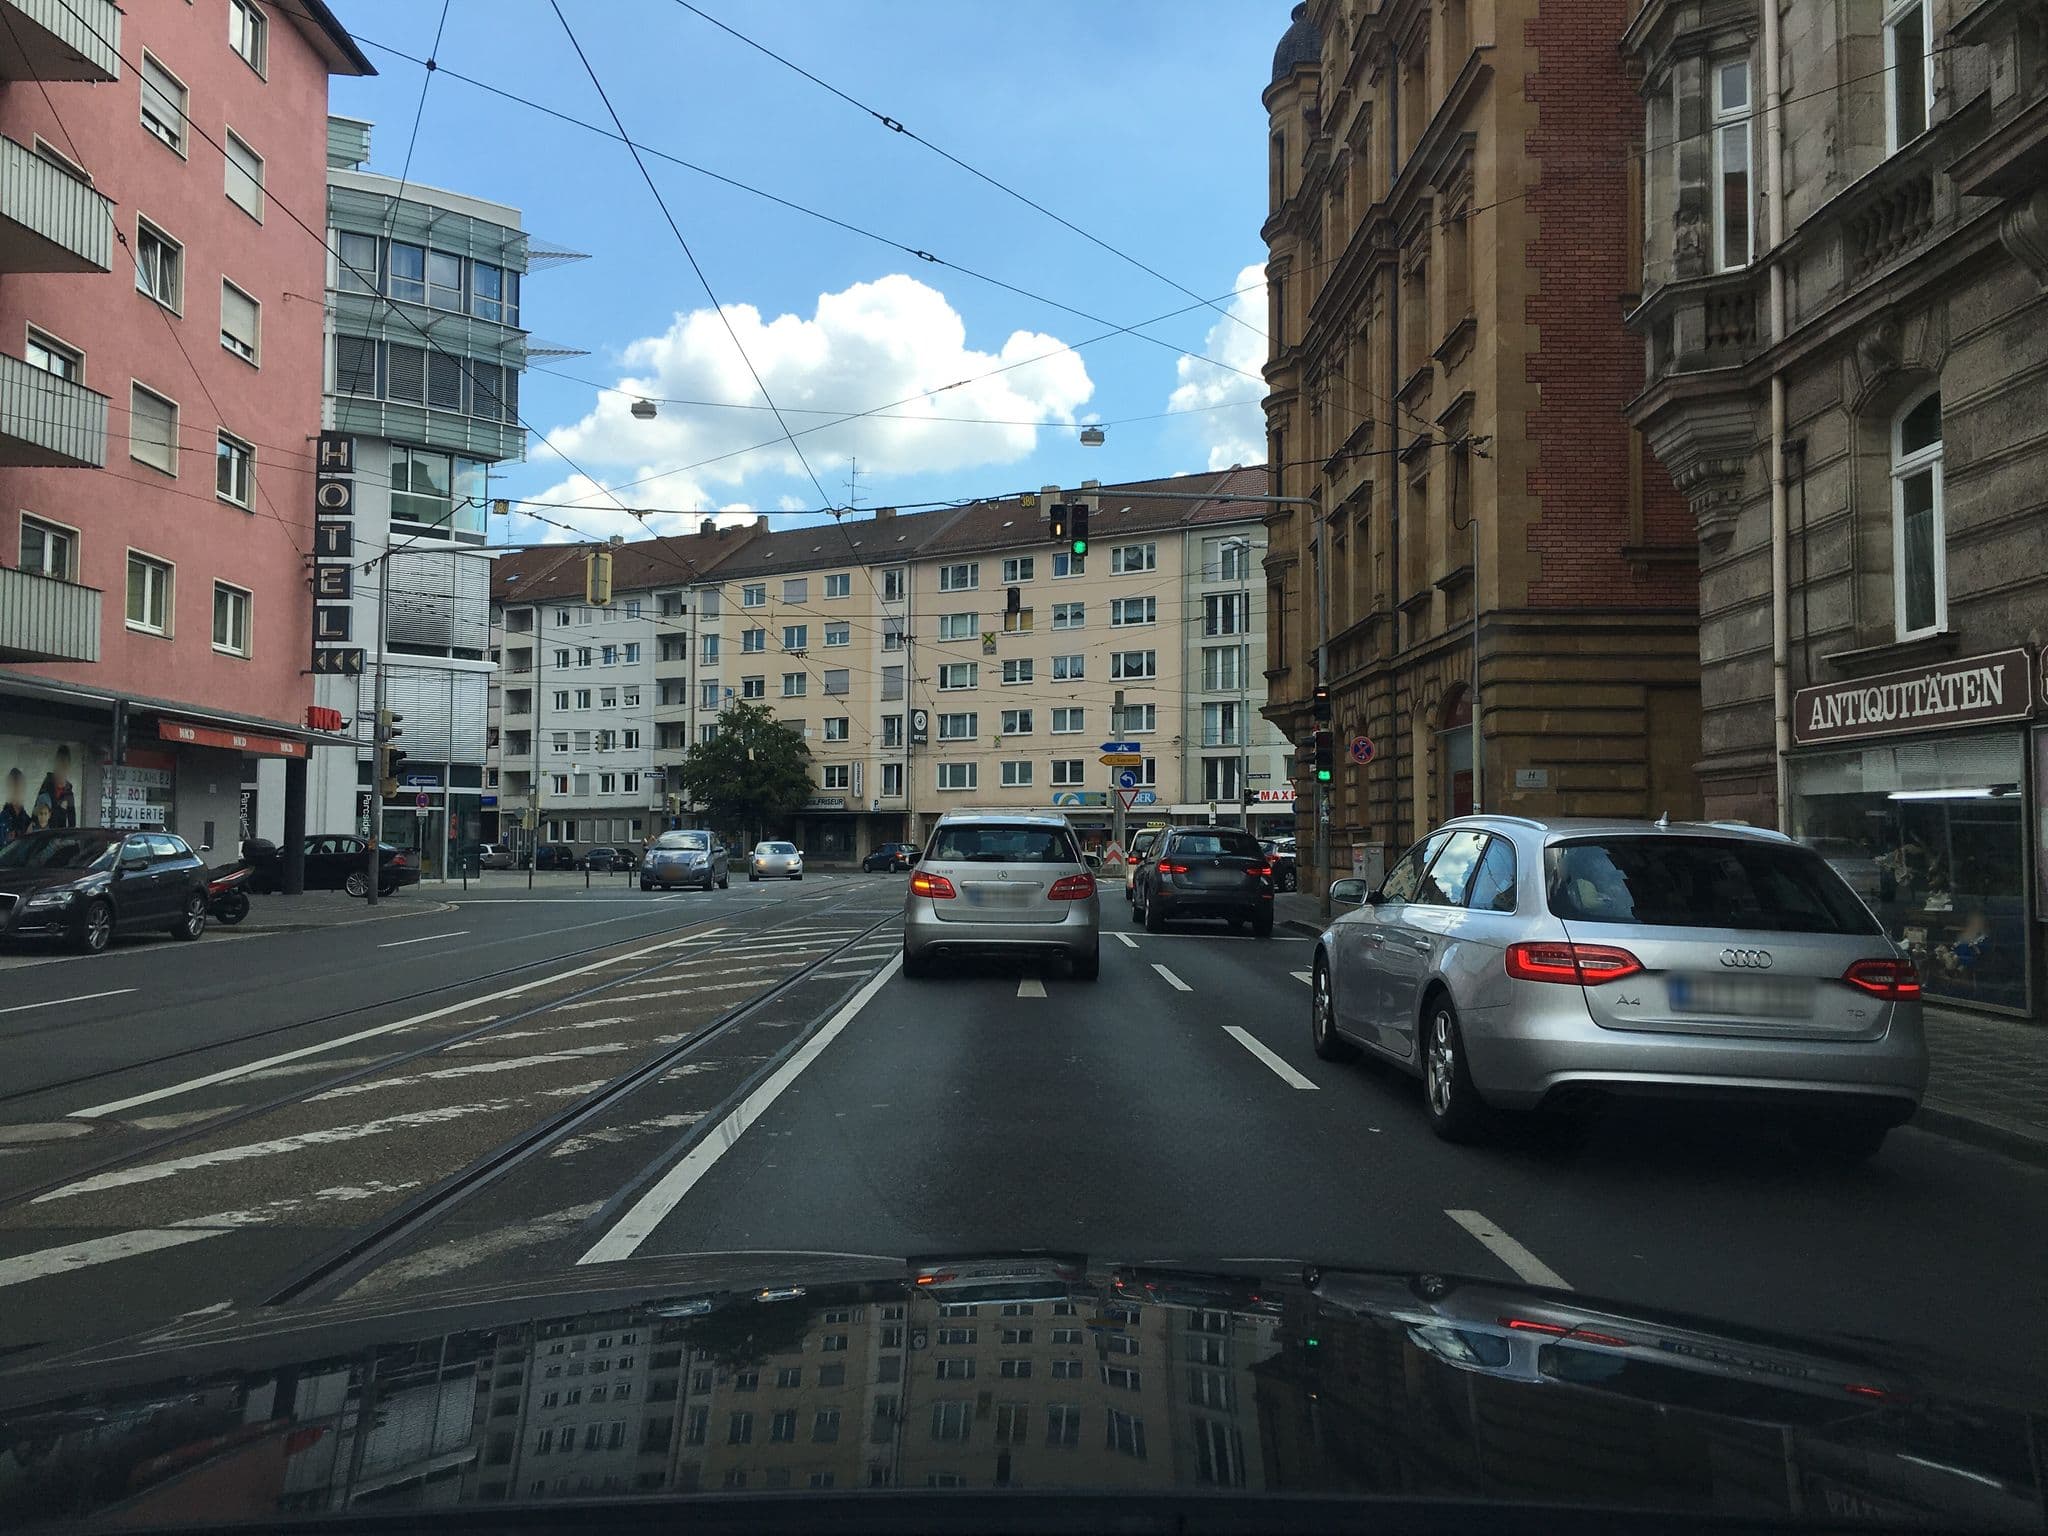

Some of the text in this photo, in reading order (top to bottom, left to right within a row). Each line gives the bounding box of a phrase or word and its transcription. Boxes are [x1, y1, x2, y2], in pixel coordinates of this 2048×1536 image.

[318, 441, 350, 637] HOTEL
[1808, 664, 2005, 731] ANTIQUITÄTEN
[313, 706, 342, 731] NKD
[179, 728, 195, 740] NKD
[101, 806, 164, 820] REDUZIERTE
[1616, 994, 1640, 1005] A4
